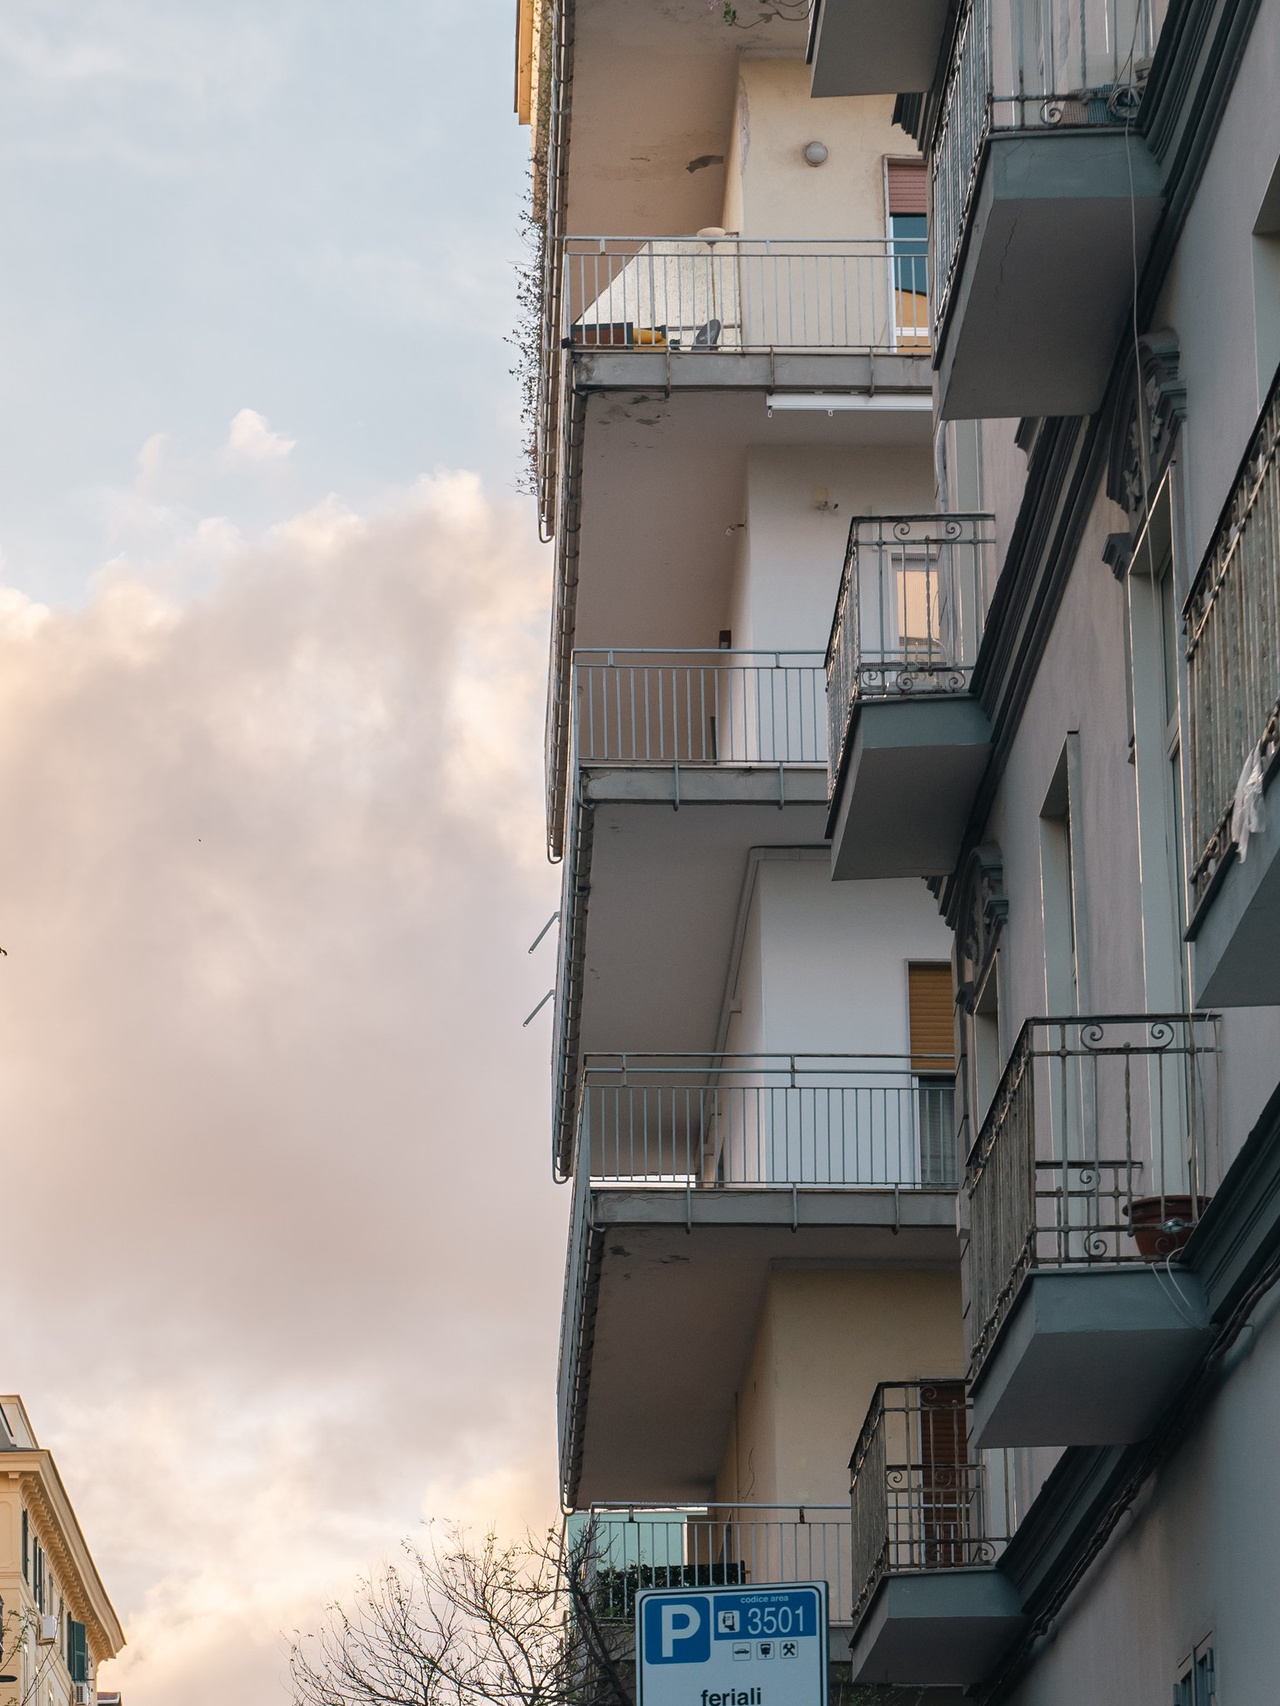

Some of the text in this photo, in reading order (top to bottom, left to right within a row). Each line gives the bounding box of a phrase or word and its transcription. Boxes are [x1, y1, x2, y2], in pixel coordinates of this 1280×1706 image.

[740, 1596, 769, 1604] codice
[661, 1603, 702, 1658] P
[747, 1605, 804, 1635] 3501
[700, 1687, 763, 1706] feriali
